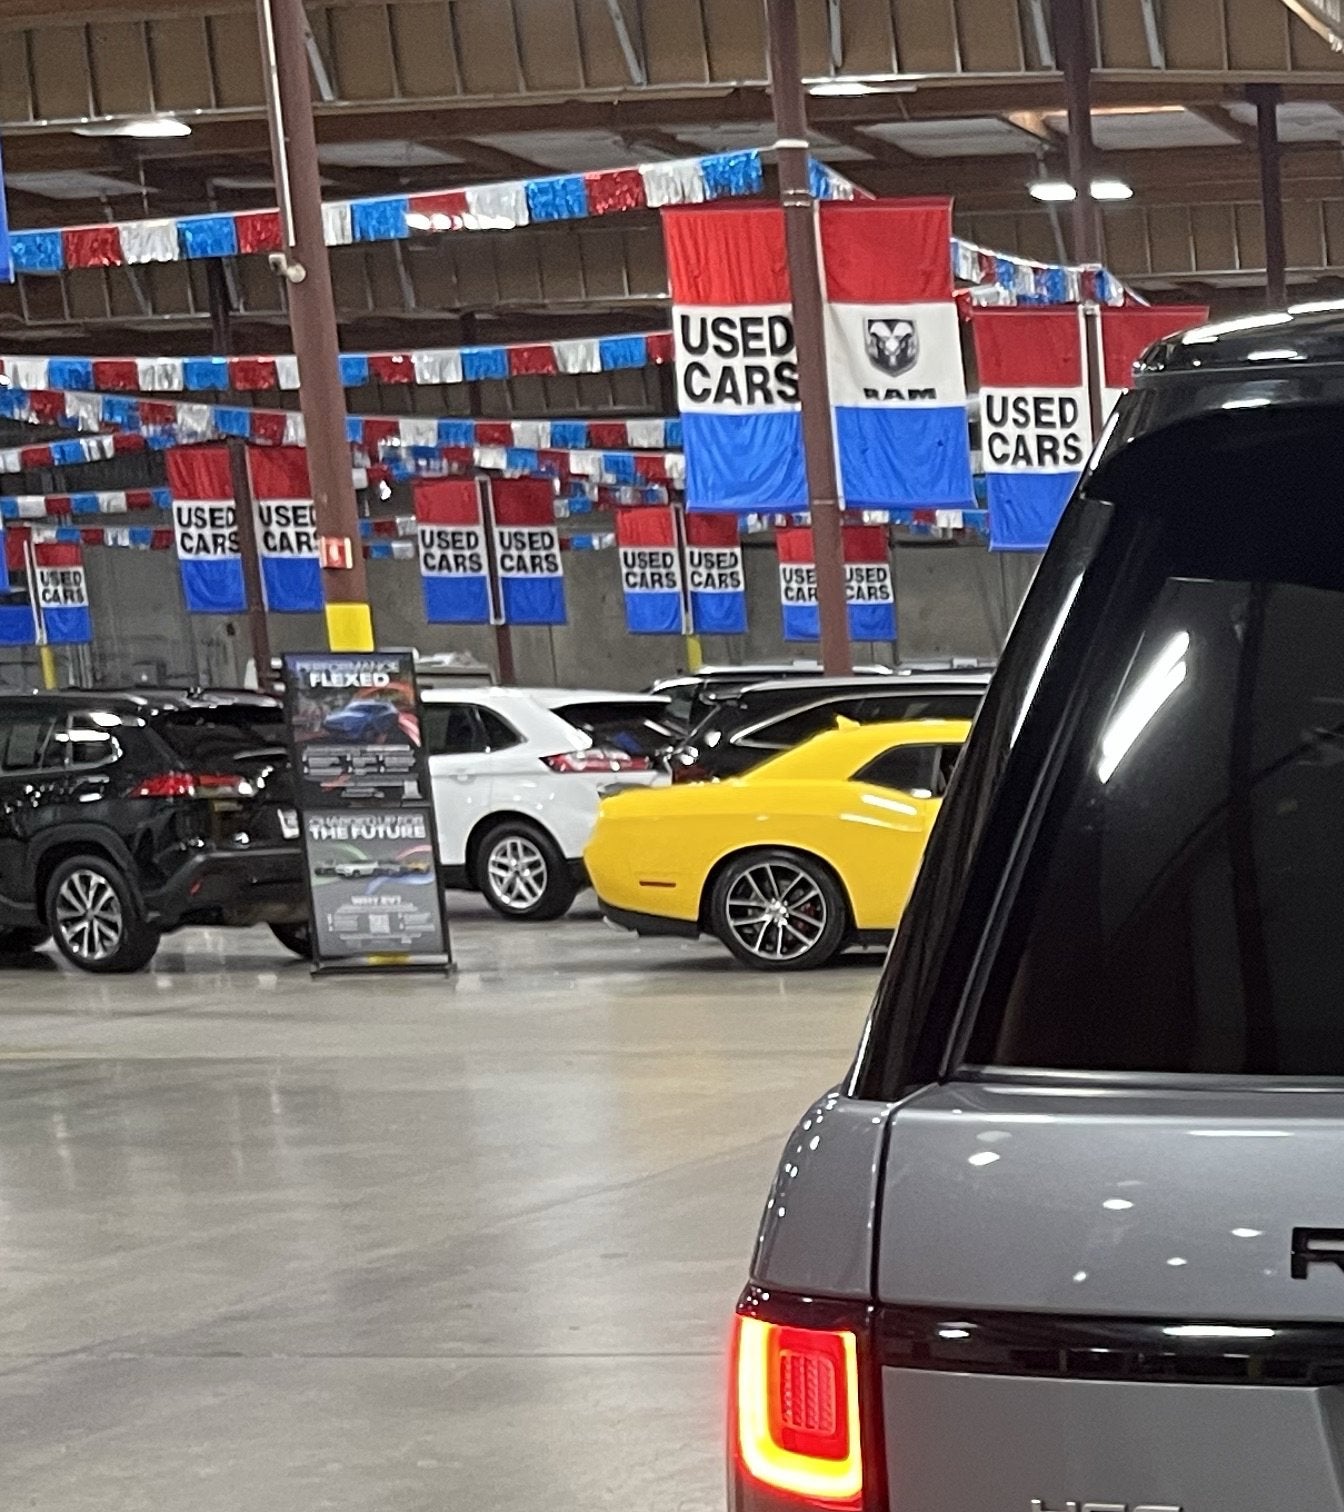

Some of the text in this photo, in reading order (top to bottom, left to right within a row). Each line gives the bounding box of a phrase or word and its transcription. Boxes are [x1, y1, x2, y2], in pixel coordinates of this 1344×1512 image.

[680, 314, 795, 359] USED
[683, 360, 801, 406] CARS
[863, 387, 937, 401] RAM
[986, 394, 1079, 430] USED
[987, 432, 1083, 467] CARS
[176, 506, 237, 529] USED
[180, 532, 240, 555] CARS
[263, 531, 319, 554] CAR
[420, 529, 480, 551] USED
[499, 530, 555, 551] USED
[422, 552, 483, 574] CARS
[500, 553, 559, 574] CARS
[623, 551, 674, 570] USED
[689, 551, 739, 570] USED
[40, 570, 82, 588] USED
[625, 571, 677, 589] CARS
[690, 571, 741, 589] CARS
[782, 567, 816, 585] USE
[784, 585, 818, 603] CAR
[309, 824, 427, 840] THE FUTURE
